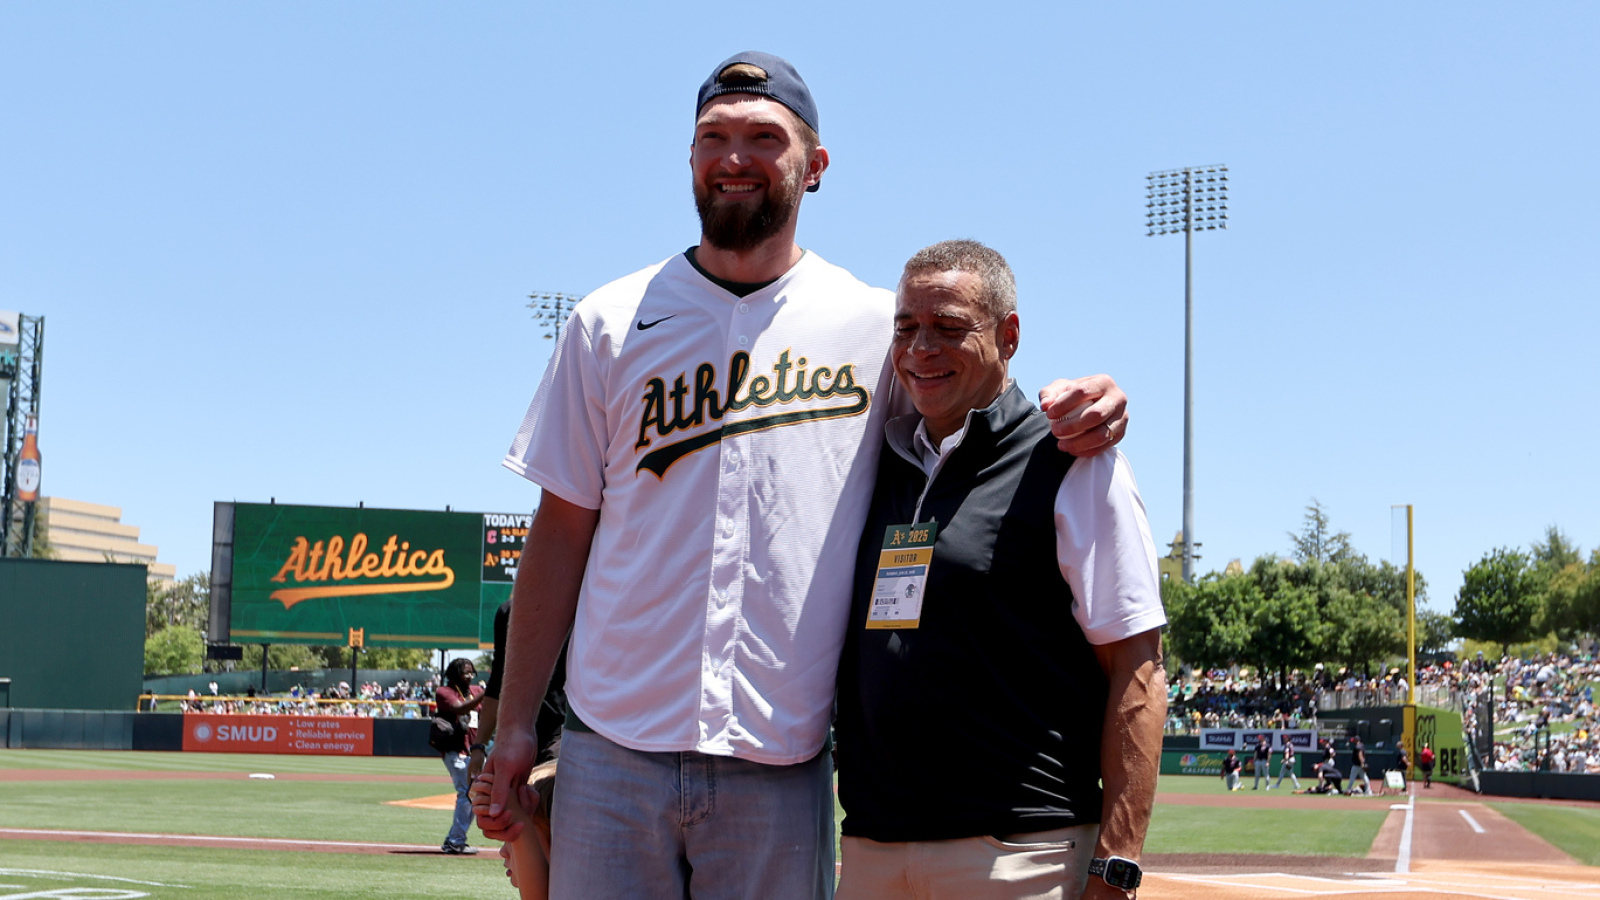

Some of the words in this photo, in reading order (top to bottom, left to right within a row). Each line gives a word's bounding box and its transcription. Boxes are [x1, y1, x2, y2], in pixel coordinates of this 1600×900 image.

[635, 347, 864, 455] Athletics
[484, 514, 533, 528] TODAY'S
[908, 529, 929, 543] 2025
[270, 532, 448, 583] Athletics
[893, 553, 918, 564] VISITOR
[296, 719, 314, 729] Low
[317, 720, 340, 730] rates
[216, 724, 277, 743] SMUD
[295, 730, 331, 739] Reliable
[334, 732, 365, 740] service
[295, 740, 321, 750] Clean
[323, 742, 354, 752] energy
[1182, 767, 1221, 775] CALIFORN
